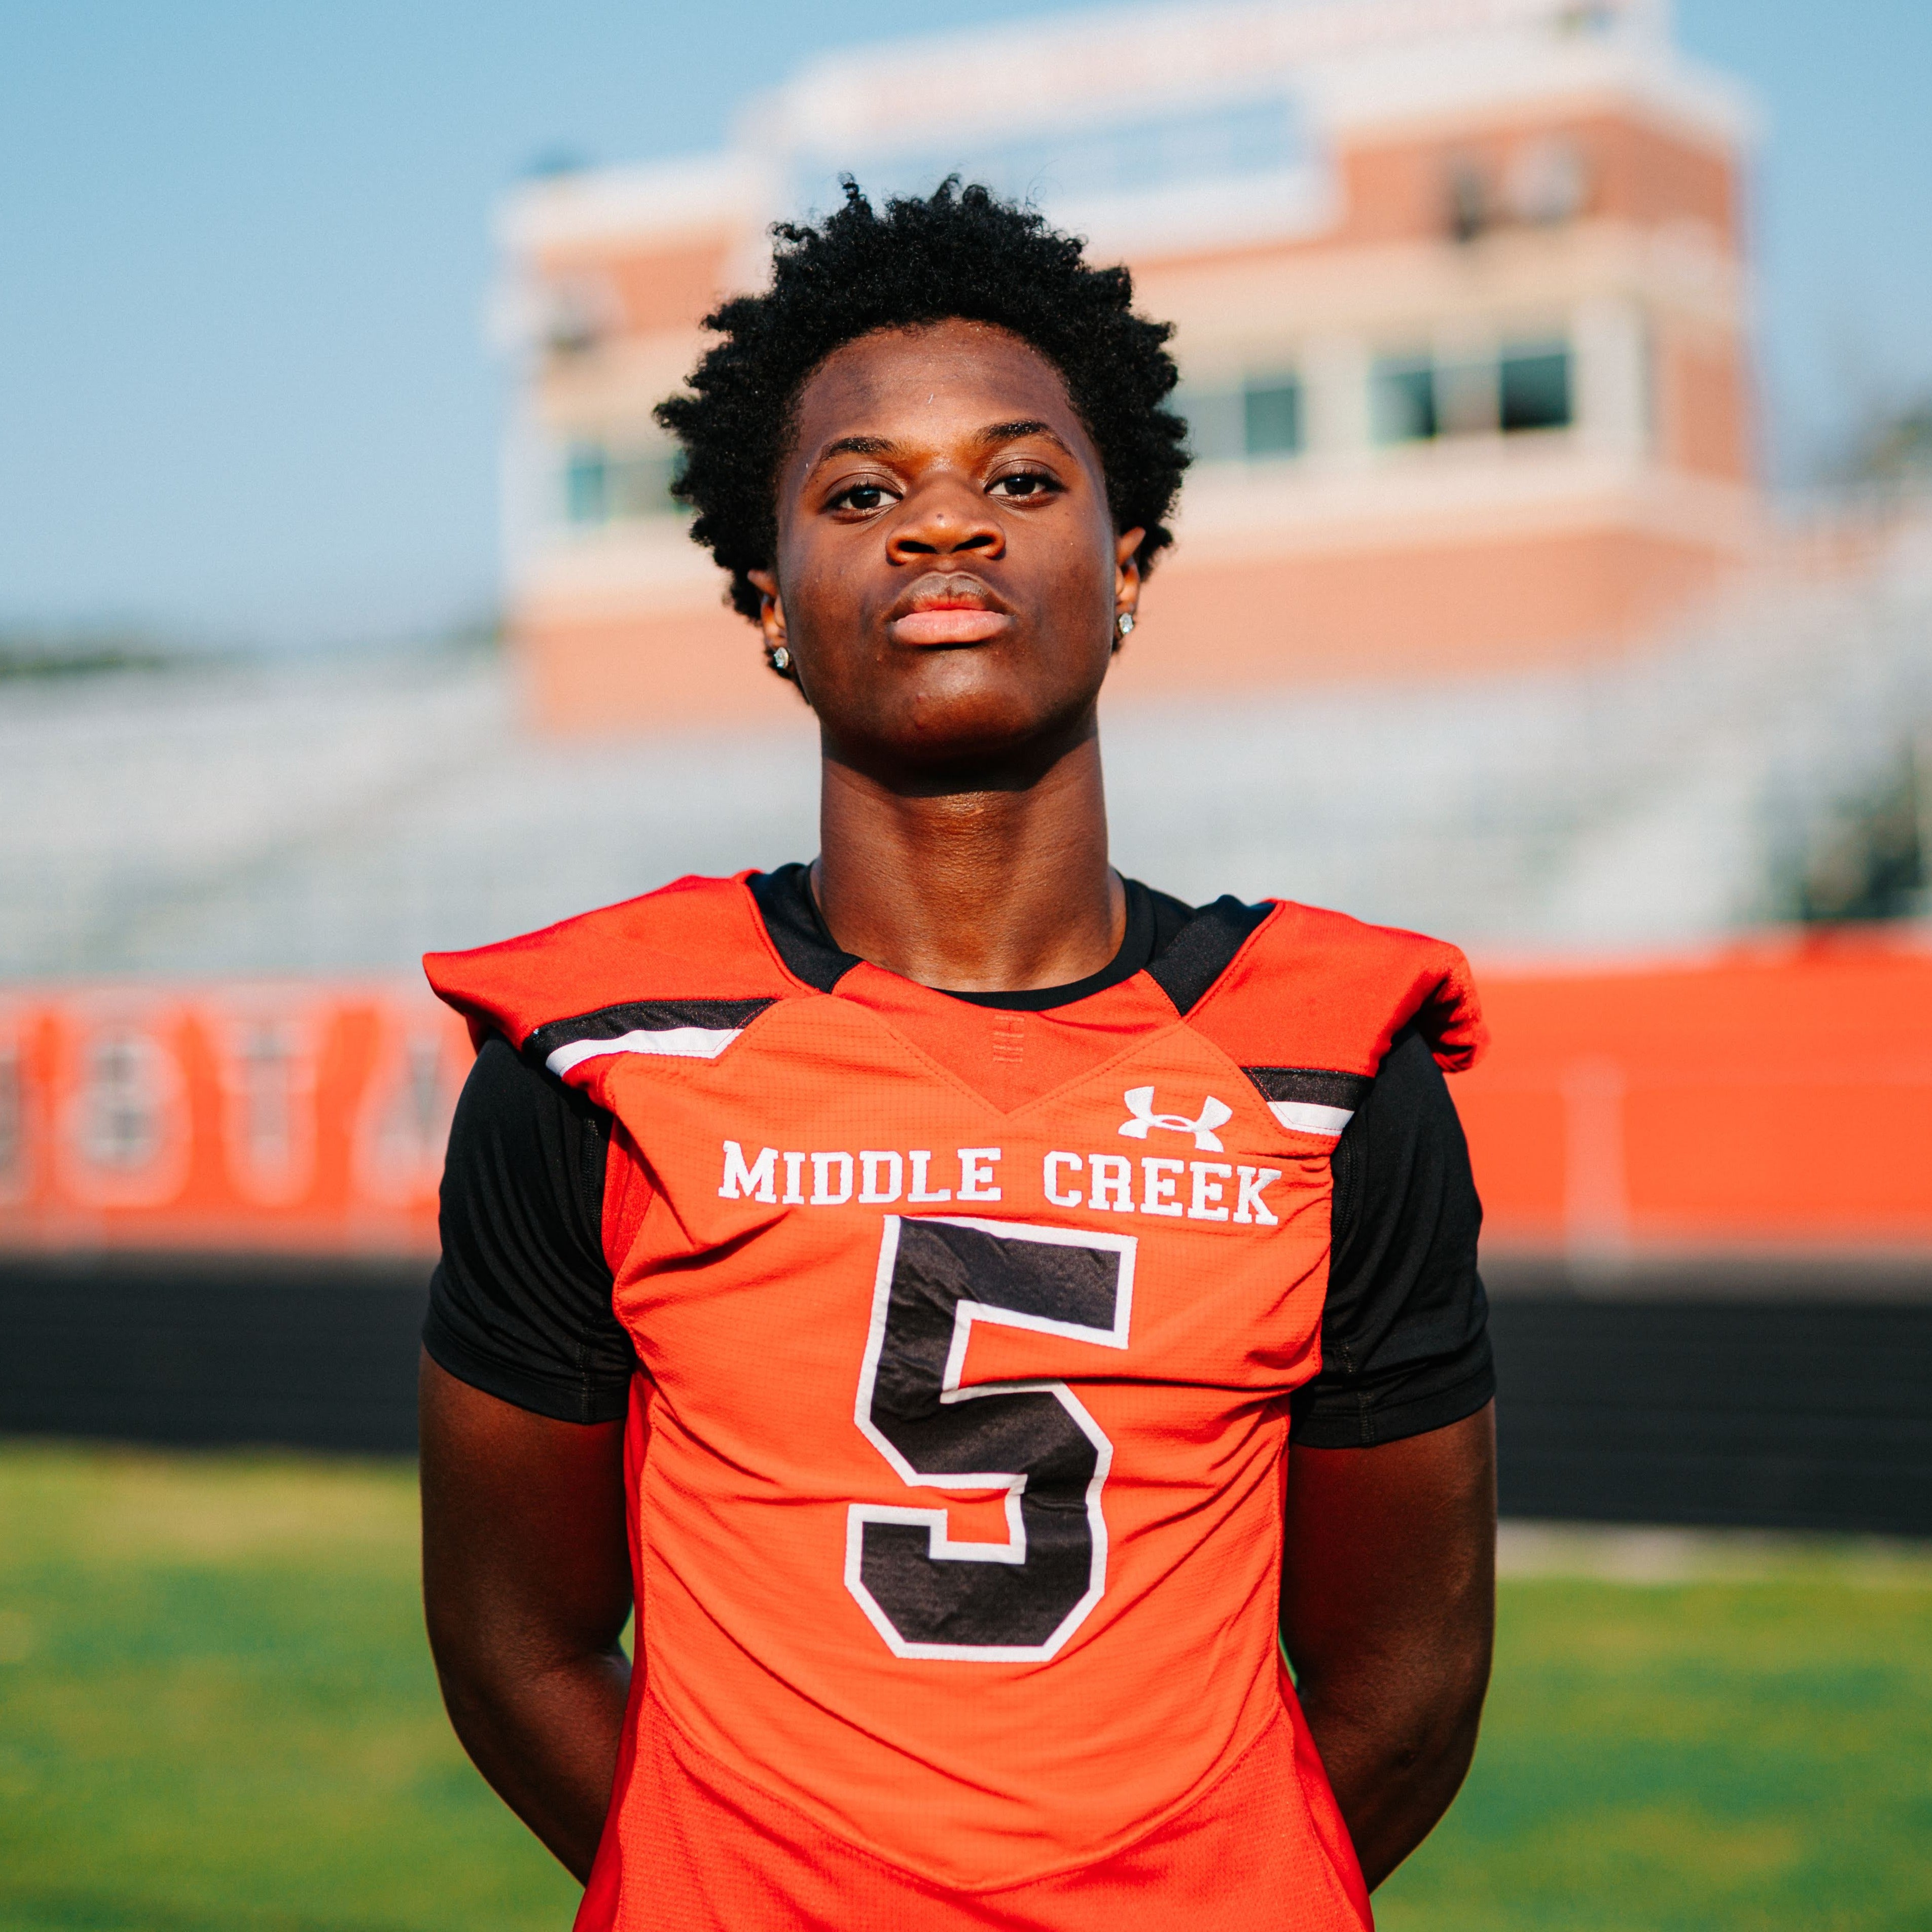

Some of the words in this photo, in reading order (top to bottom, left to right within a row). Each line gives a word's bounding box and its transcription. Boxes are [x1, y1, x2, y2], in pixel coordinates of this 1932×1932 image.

[718, 1139, 1002, 1206] MIDDLE
[1043, 1150, 1282, 1226] CREEK
[843, 1214, 1138, 1663] 5
